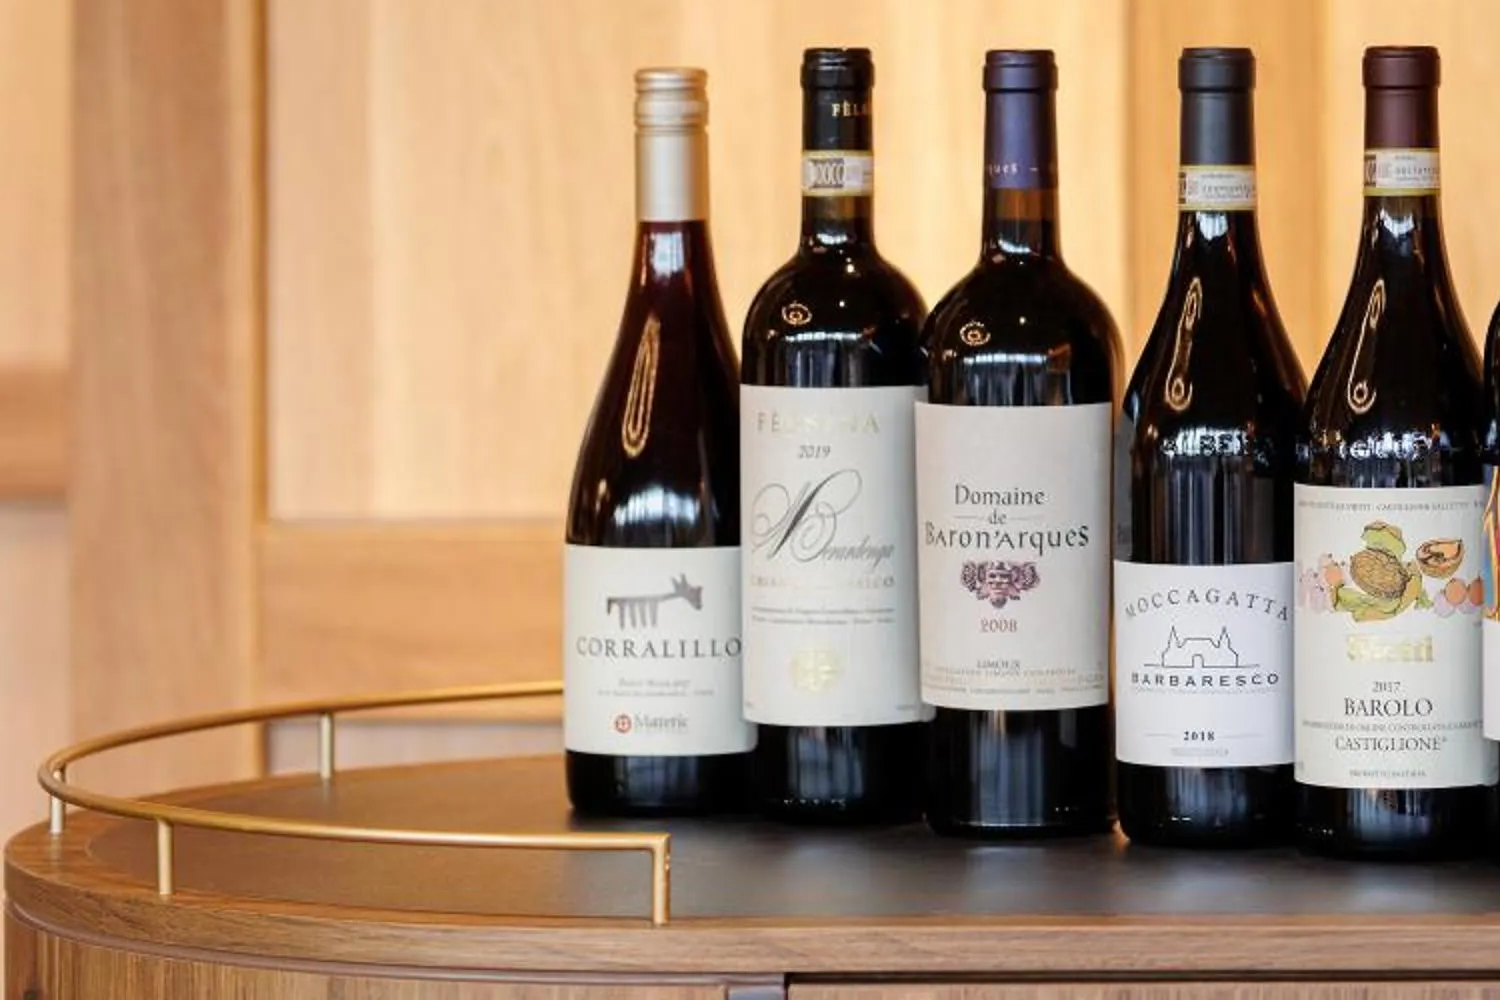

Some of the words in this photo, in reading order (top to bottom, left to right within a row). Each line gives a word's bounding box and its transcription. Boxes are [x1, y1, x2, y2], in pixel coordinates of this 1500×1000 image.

[797, 445, 830, 458] 2019
[955, 484, 1046, 505] Domaine
[988, 509, 1007, 524] de
[1124, 587, 1289, 621] MOCCAGATTA
[576, 636, 742, 659] CORRALILLO
[1131, 672, 1280, 687] BARBARESCO
[1344, 697, 1433, 717] BAROLO
[1183, 731, 1215, 742] 2018
